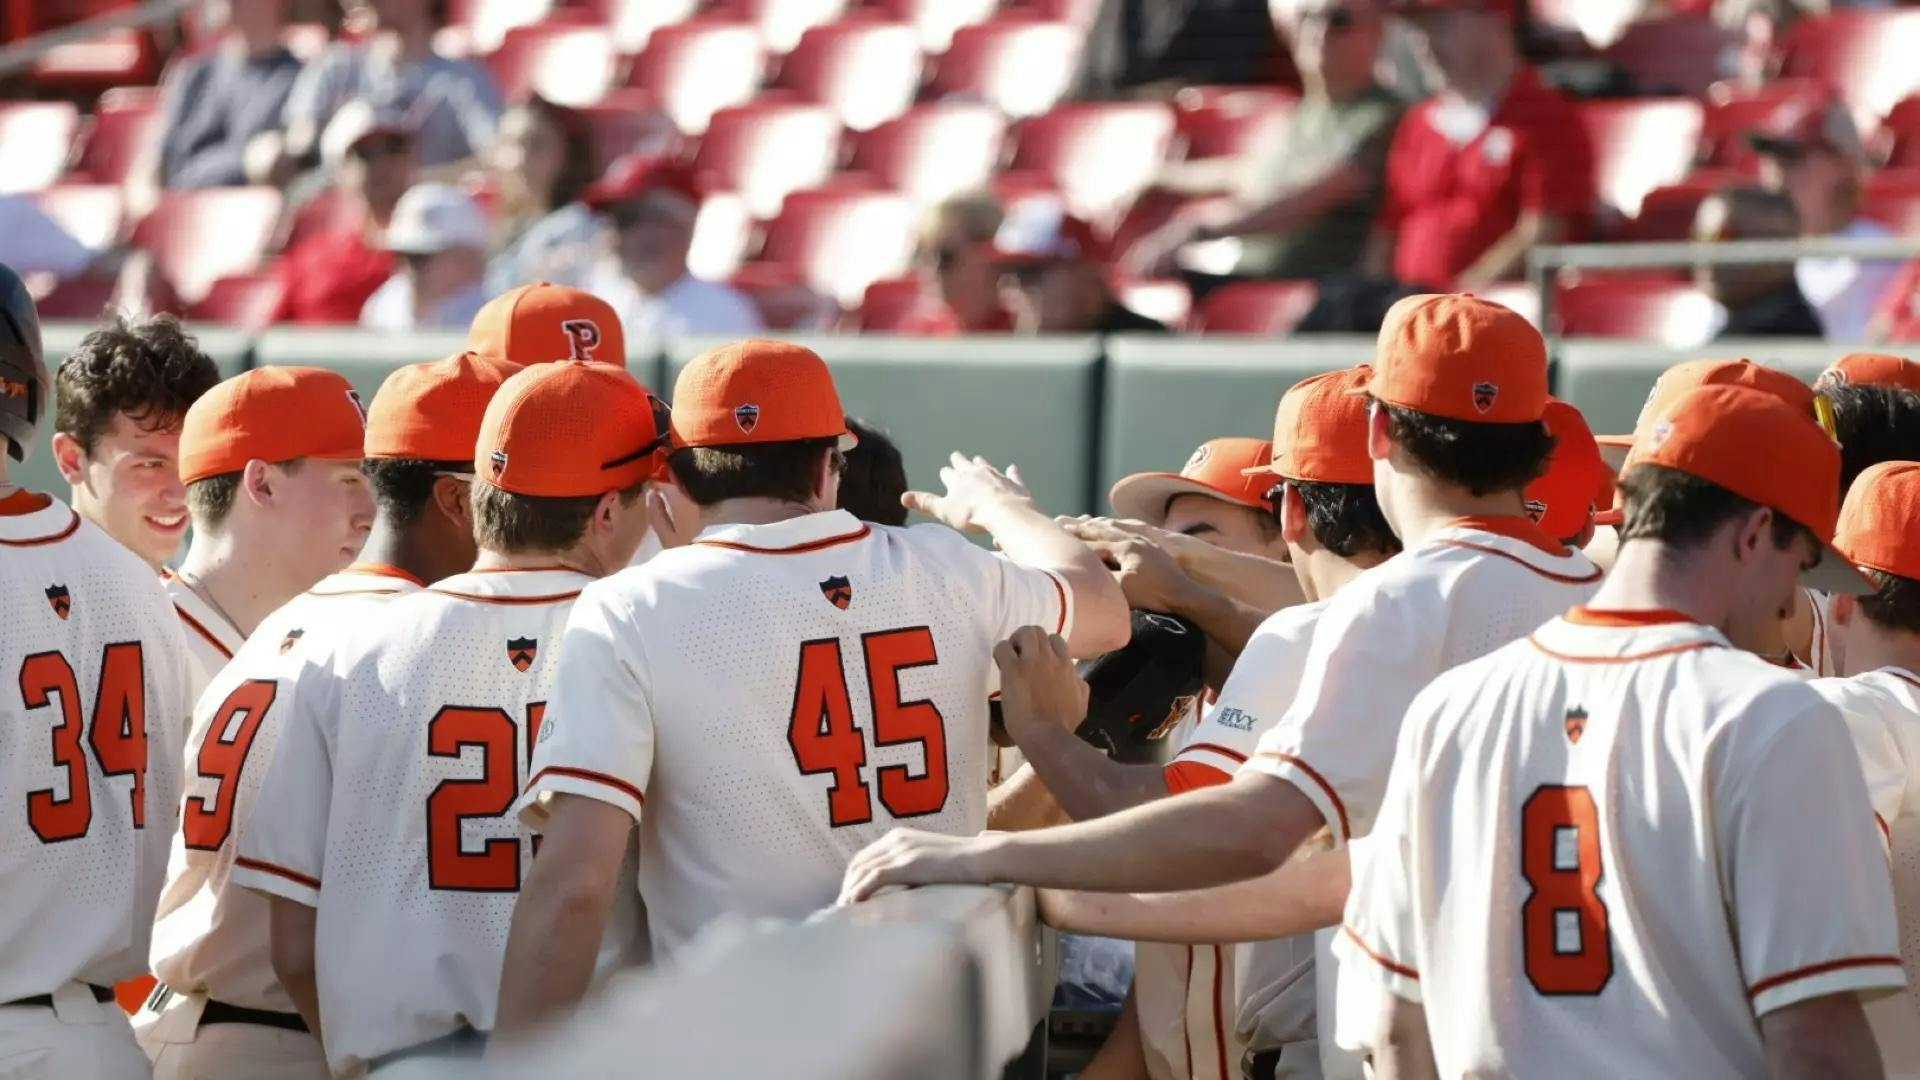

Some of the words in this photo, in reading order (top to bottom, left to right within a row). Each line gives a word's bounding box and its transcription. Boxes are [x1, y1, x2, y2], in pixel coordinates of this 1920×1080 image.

[562, 319, 600, 361] P
[19, 640, 148, 844] 34
[183, 679, 278, 851] 9
[427, 701, 547, 892] 2
[788, 626, 948, 828] 45
[1521, 784, 1615, 997] 8
